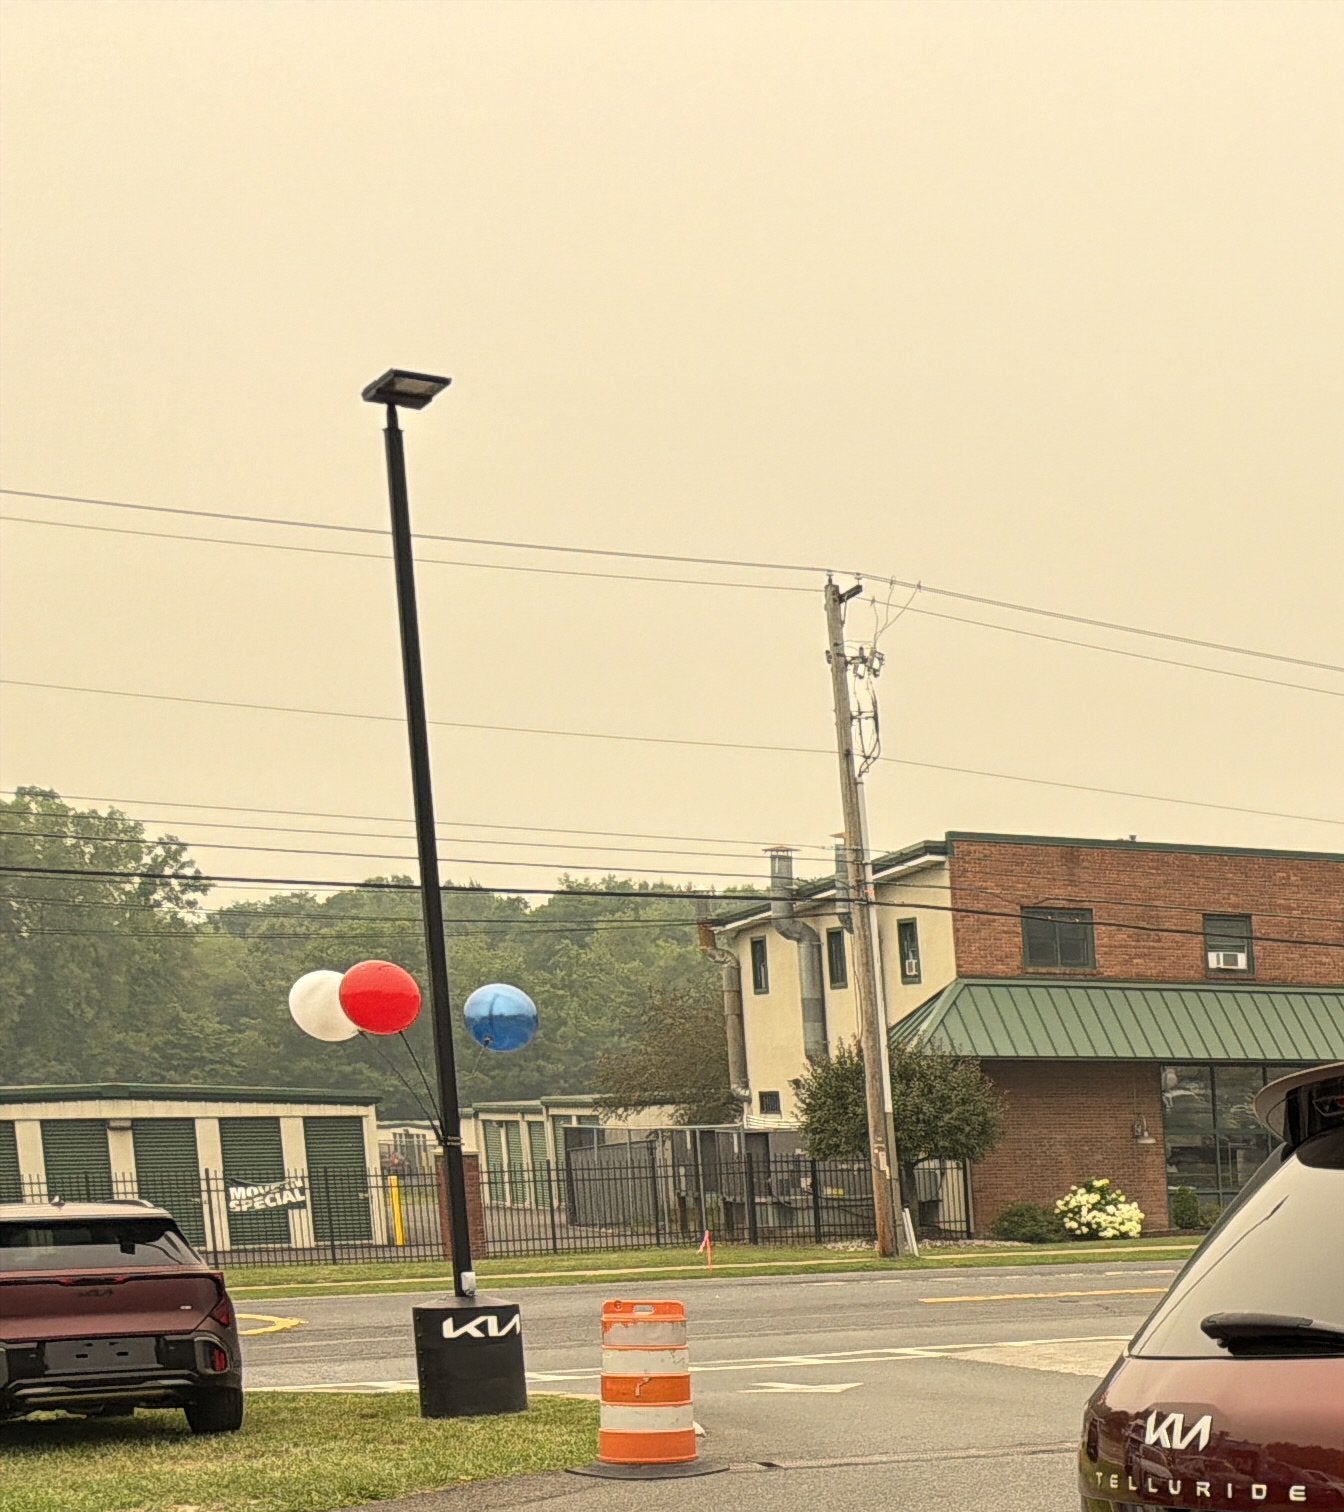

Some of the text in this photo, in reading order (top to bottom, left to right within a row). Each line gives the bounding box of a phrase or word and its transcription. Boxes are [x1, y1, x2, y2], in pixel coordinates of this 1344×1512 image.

[228, 1188, 306, 1212] SPECIAL
[443, 1313, 520, 1339] KIA
[1144, 1411, 1212, 1451] KIA
[1095, 1471, 1307, 1502] TELLURIDE
